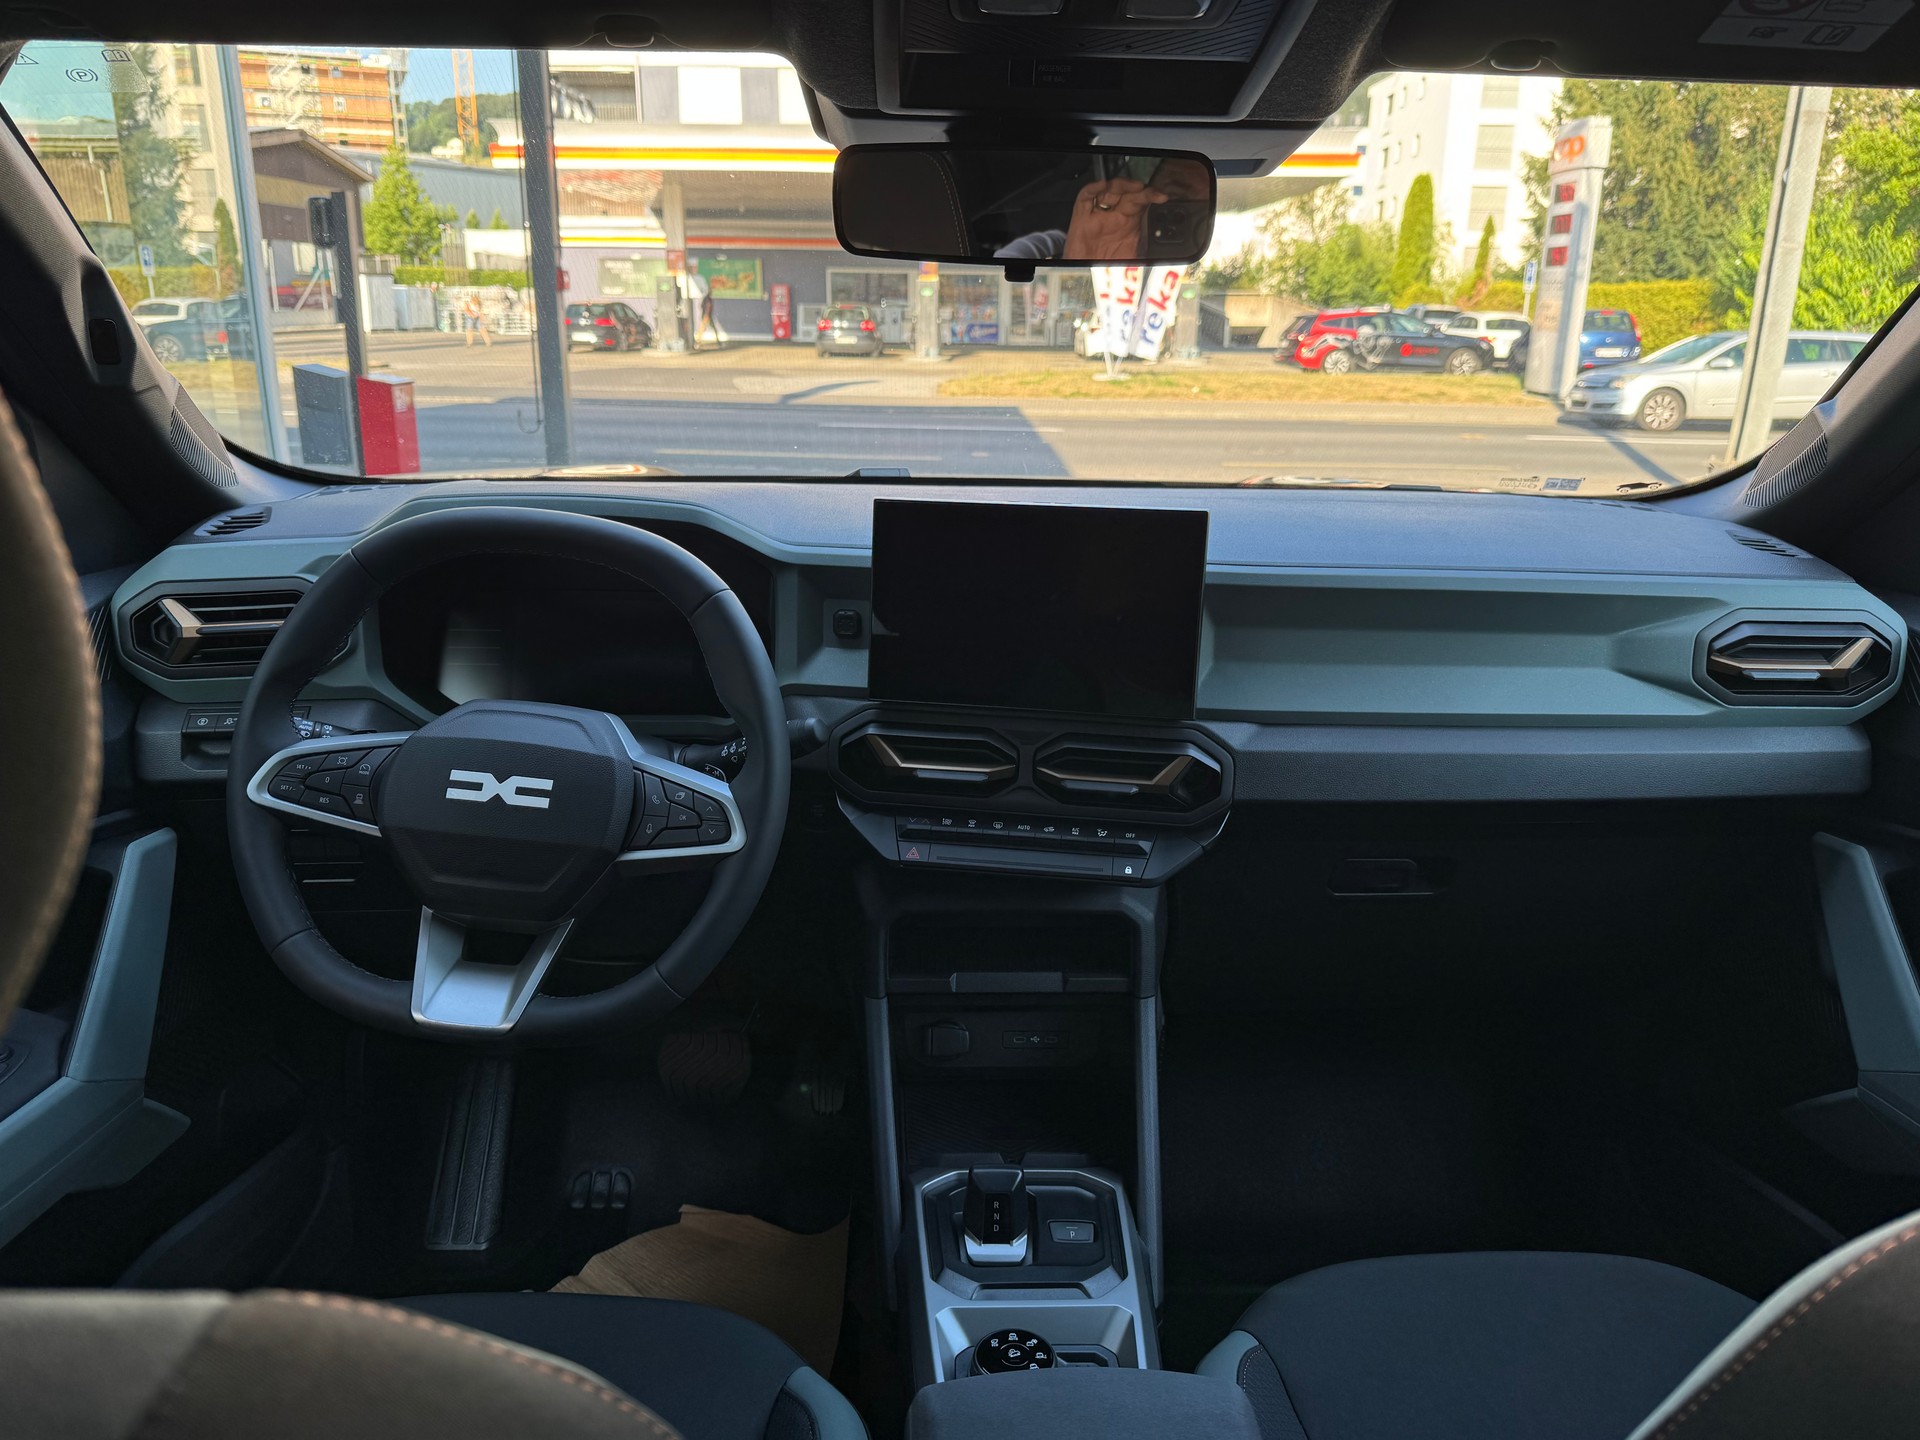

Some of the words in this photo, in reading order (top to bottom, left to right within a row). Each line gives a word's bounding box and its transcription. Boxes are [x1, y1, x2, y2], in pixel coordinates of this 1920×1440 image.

[1140, 269, 1179, 345] reka
[993, 1201, 1000, 1209] R
[1070, 1231, 1075, 1239] P
